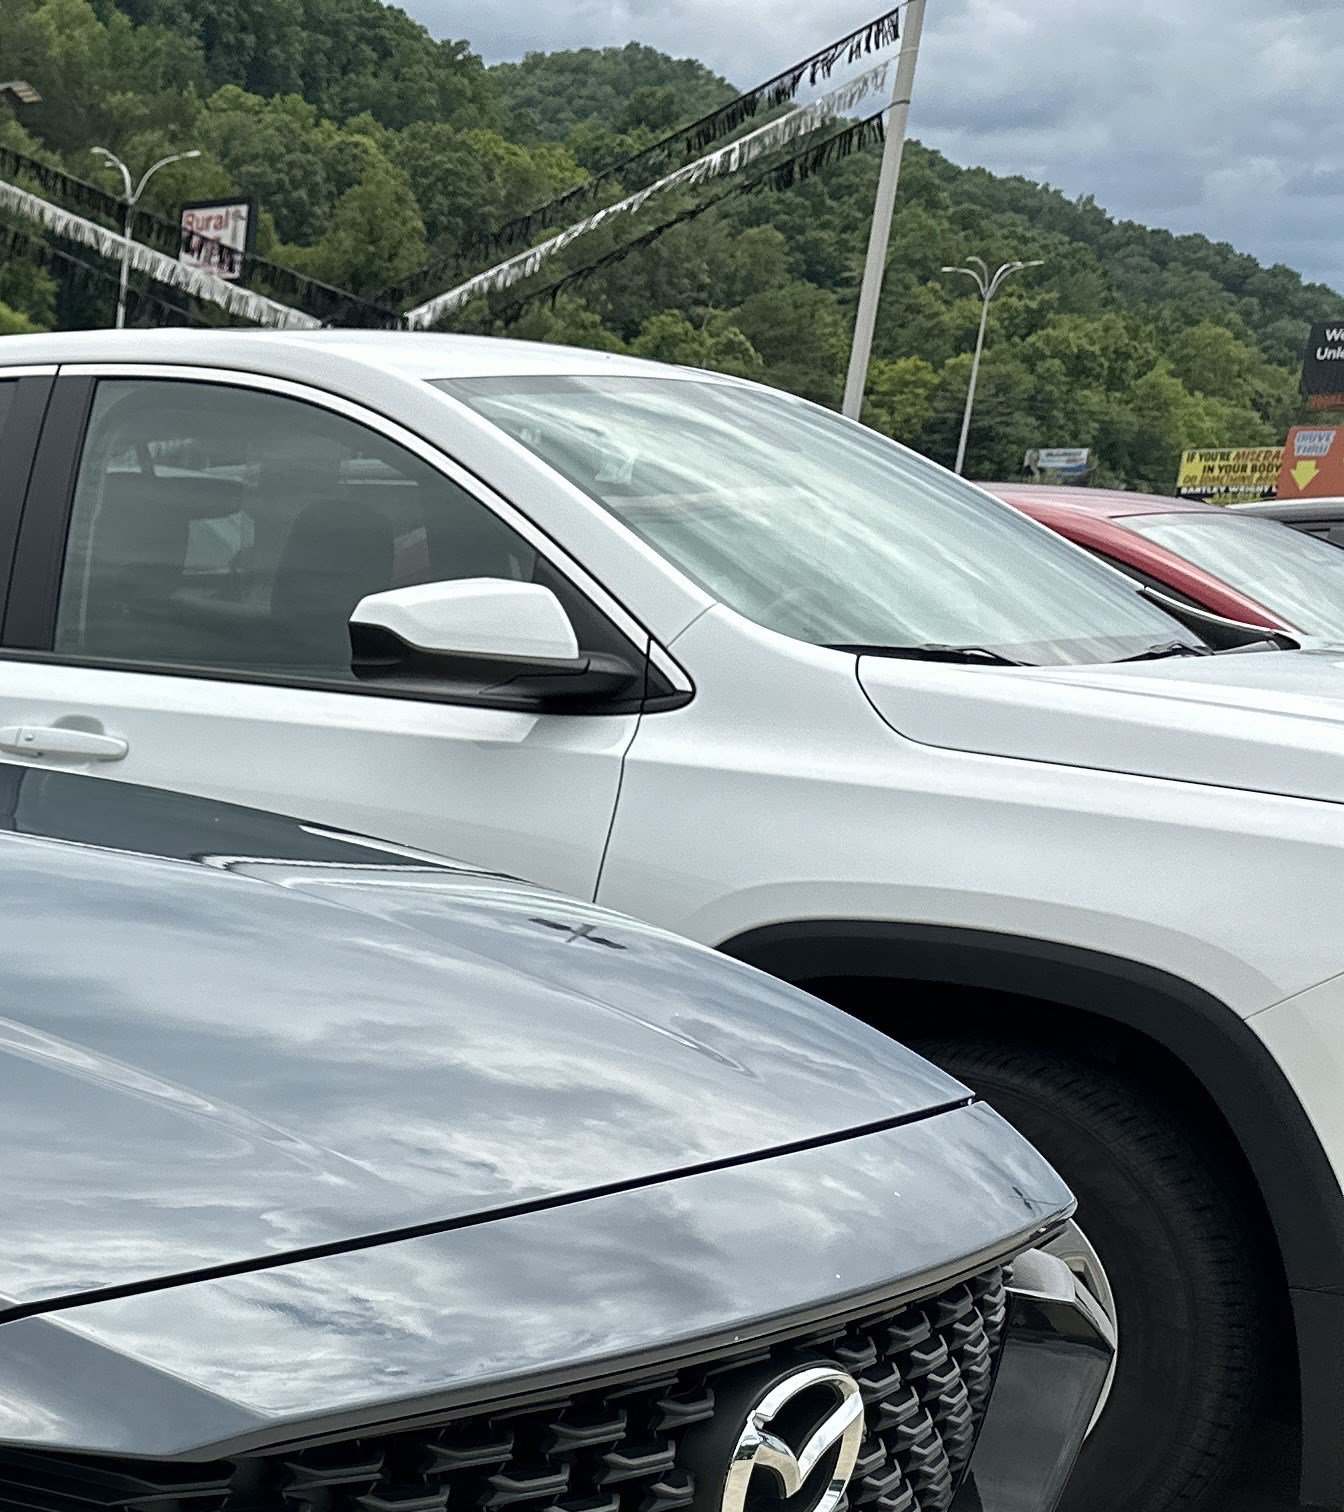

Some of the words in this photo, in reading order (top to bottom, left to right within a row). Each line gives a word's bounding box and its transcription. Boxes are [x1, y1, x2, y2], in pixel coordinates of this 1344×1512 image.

[1202, 463, 1215, 474] IN
[1217, 463, 1248, 473] YOUR
[1251, 462, 1282, 473] BODY
